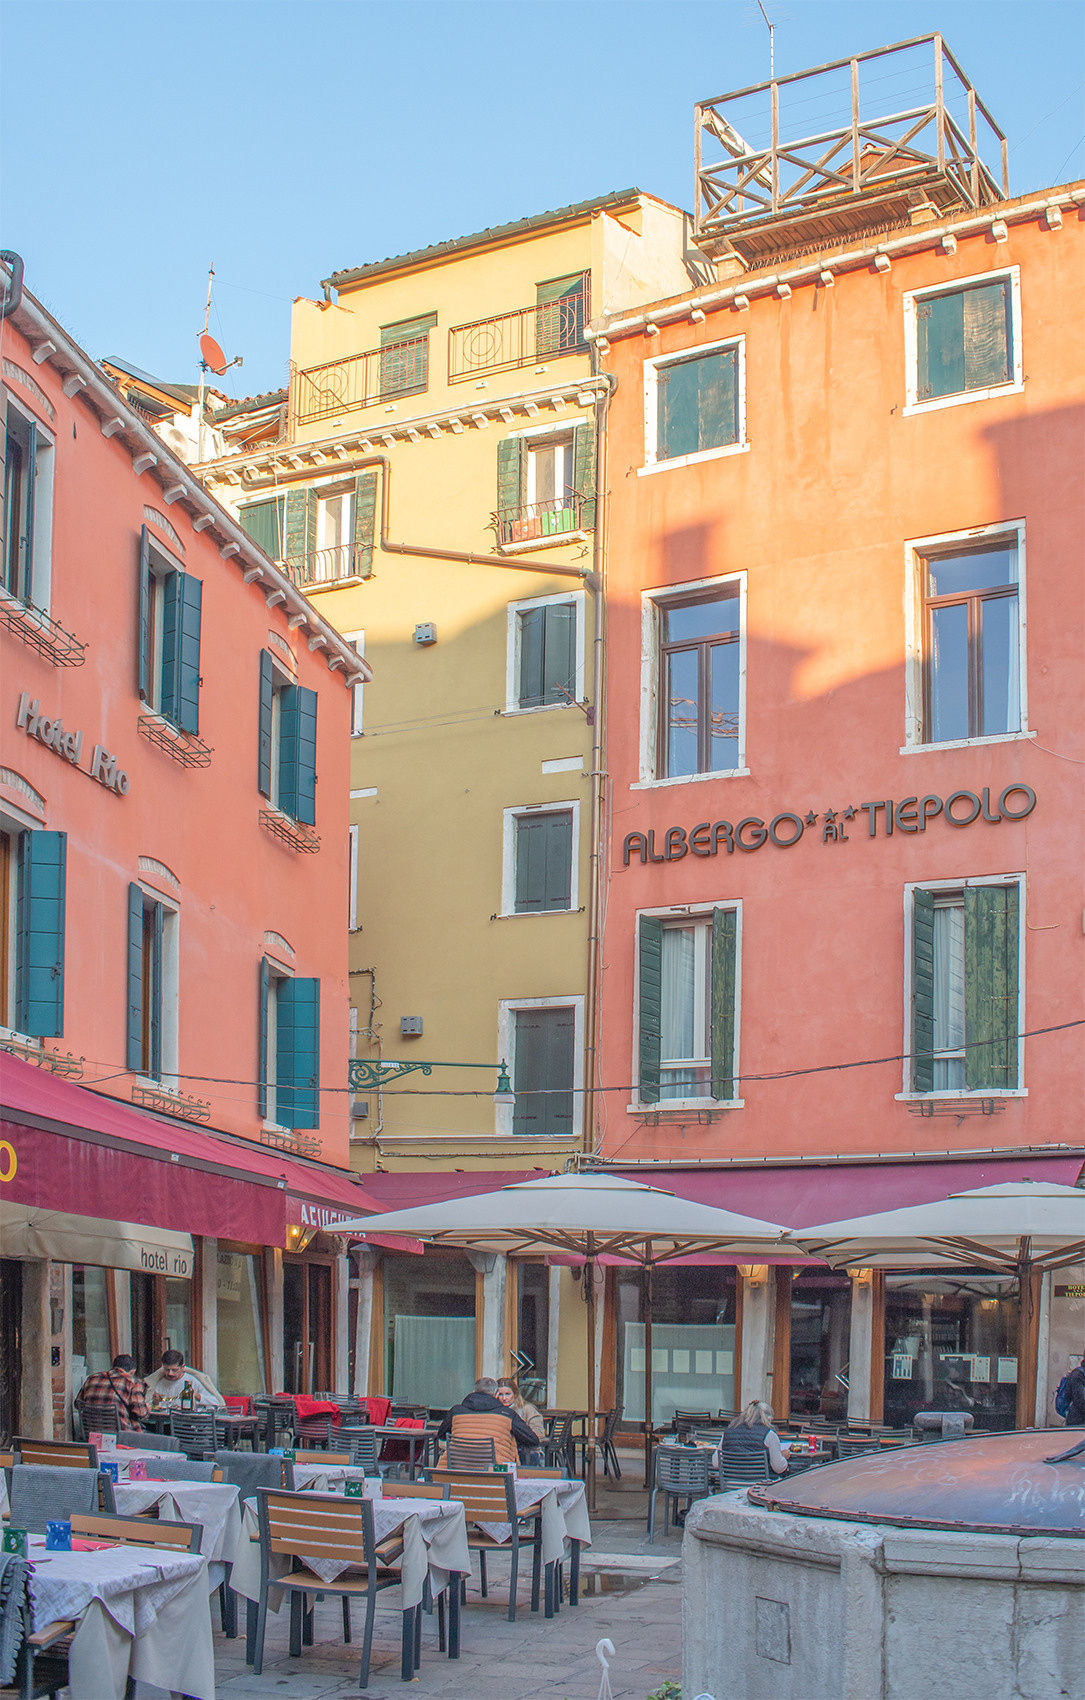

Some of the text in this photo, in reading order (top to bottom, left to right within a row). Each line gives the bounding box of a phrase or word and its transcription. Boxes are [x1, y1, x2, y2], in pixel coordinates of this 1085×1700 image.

[17, 691, 129, 796] Hotel Rio
[623, 783, 1037, 866] ALBERGO AL TIEPOLO
[141, 1247, 187, 1274] hotel rio
